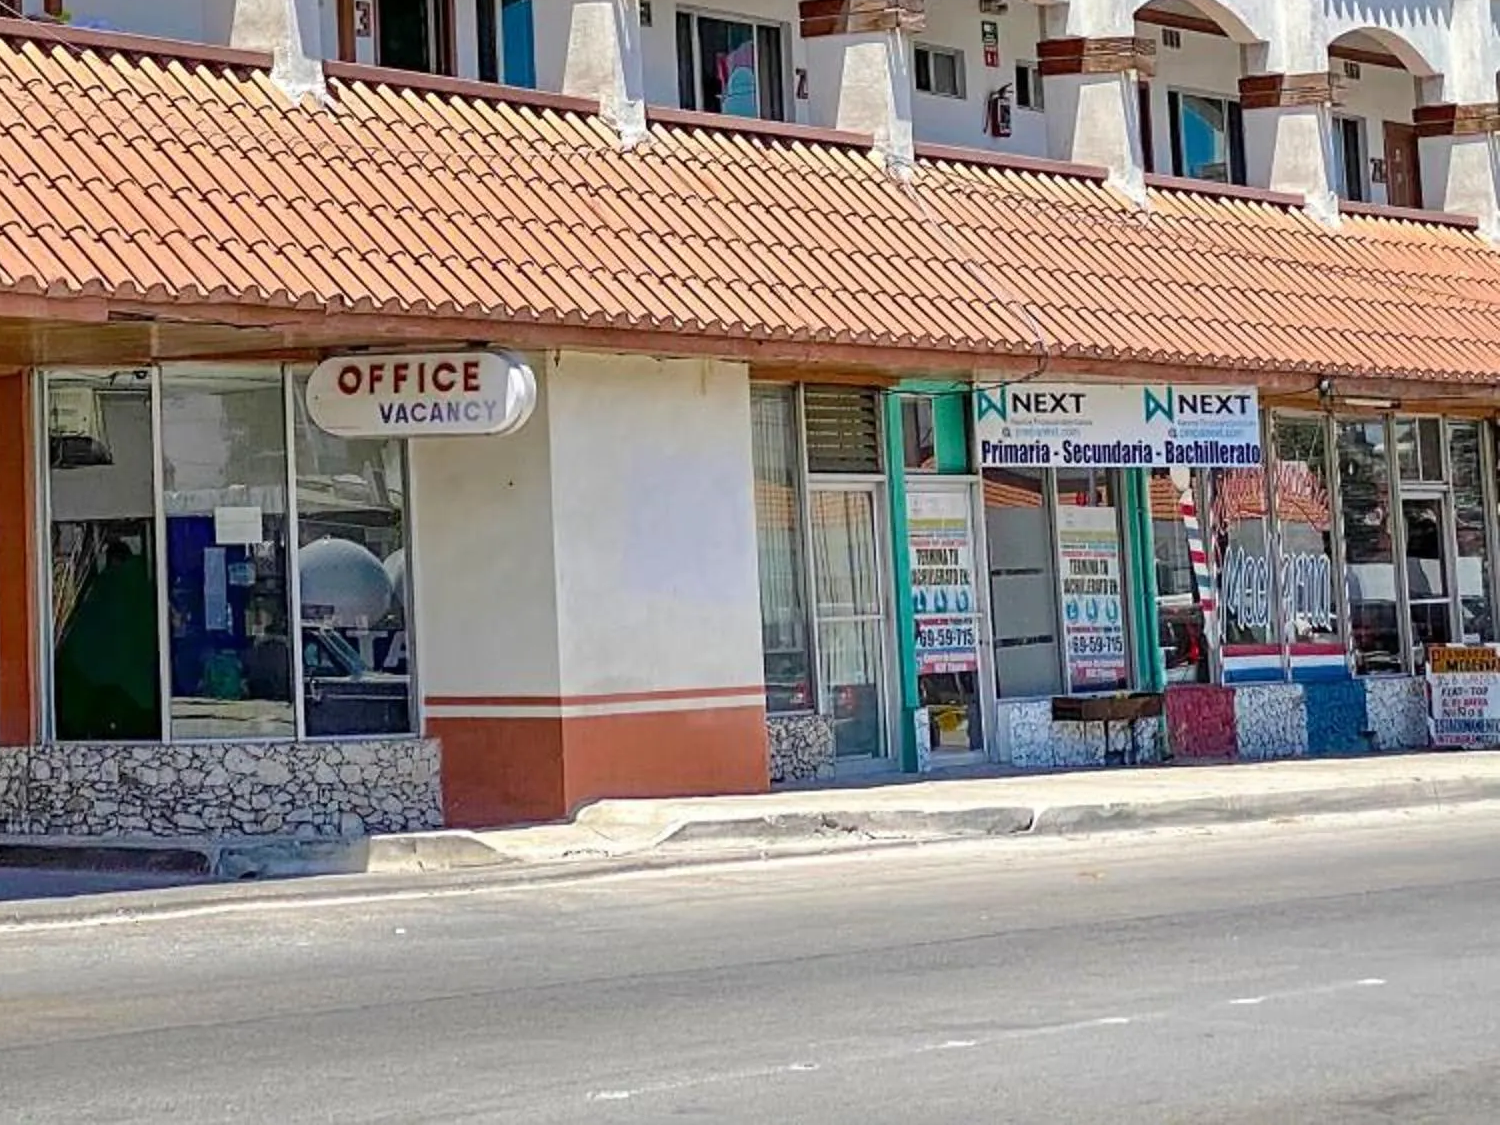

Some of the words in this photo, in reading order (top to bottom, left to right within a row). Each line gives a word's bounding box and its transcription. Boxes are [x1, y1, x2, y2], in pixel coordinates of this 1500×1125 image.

[338, 360, 481, 395] OFFICE
[379, 400, 497, 424] VACANCY
[1011, 392, 1086, 414] NEXT
[1178, 394, 1251, 414] NEXT
[981, 440, 1050, 464] Primaria
[1063, 440, 1151, 464] Secundaria
[1165, 440, 1260, 464] Bachillerato
